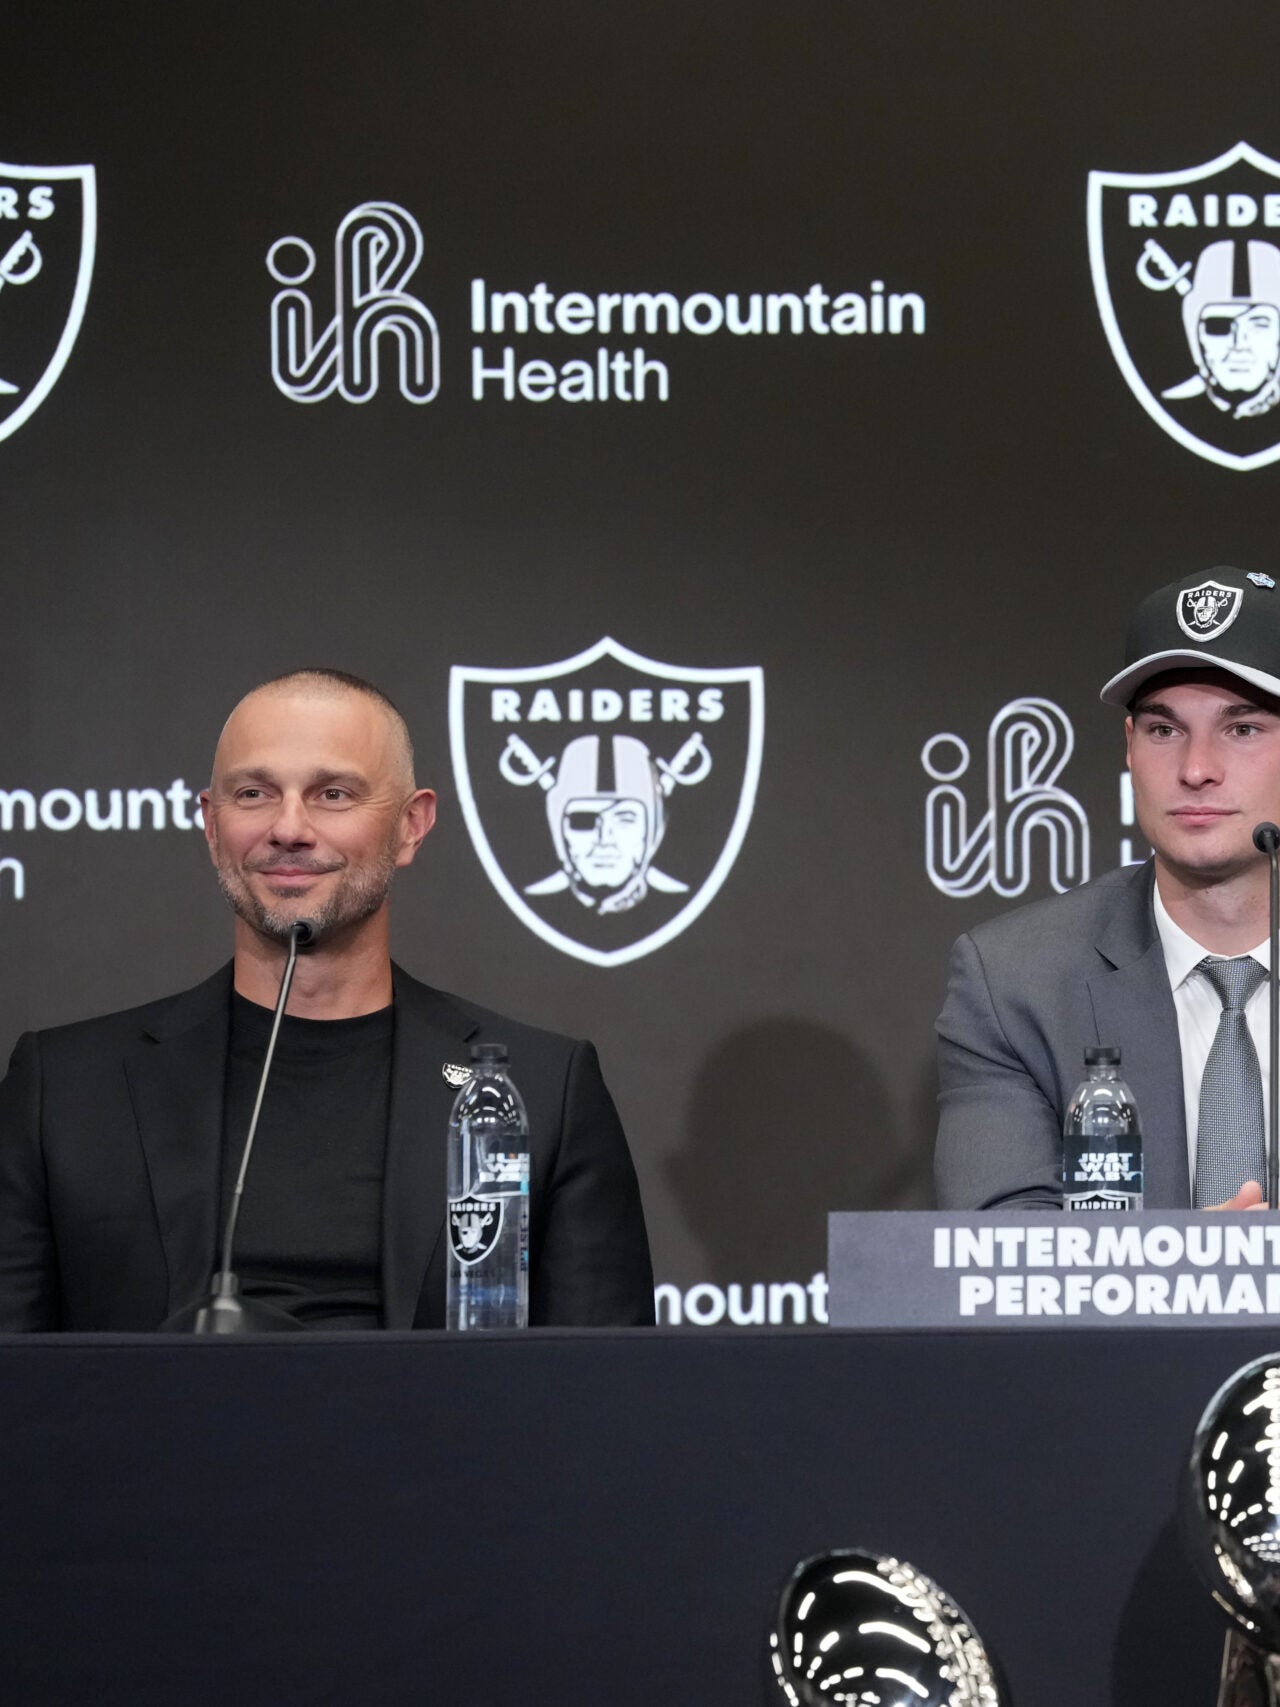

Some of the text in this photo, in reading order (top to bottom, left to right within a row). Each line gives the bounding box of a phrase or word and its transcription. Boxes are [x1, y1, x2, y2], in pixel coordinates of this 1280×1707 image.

[471, 278, 925, 335] Intermountain
[471, 347, 669, 402] Health
[1187, 590, 1232, 598] RAIDERS
[490, 688, 725, 722] RAIDERS
[1078, 1152, 1133, 1163] JUST
[1079, 1162, 1130, 1173] WIN
[1074, 1171, 1134, 1182] BABY
[1074, 1201, 1122, 1210] RAIDERS
